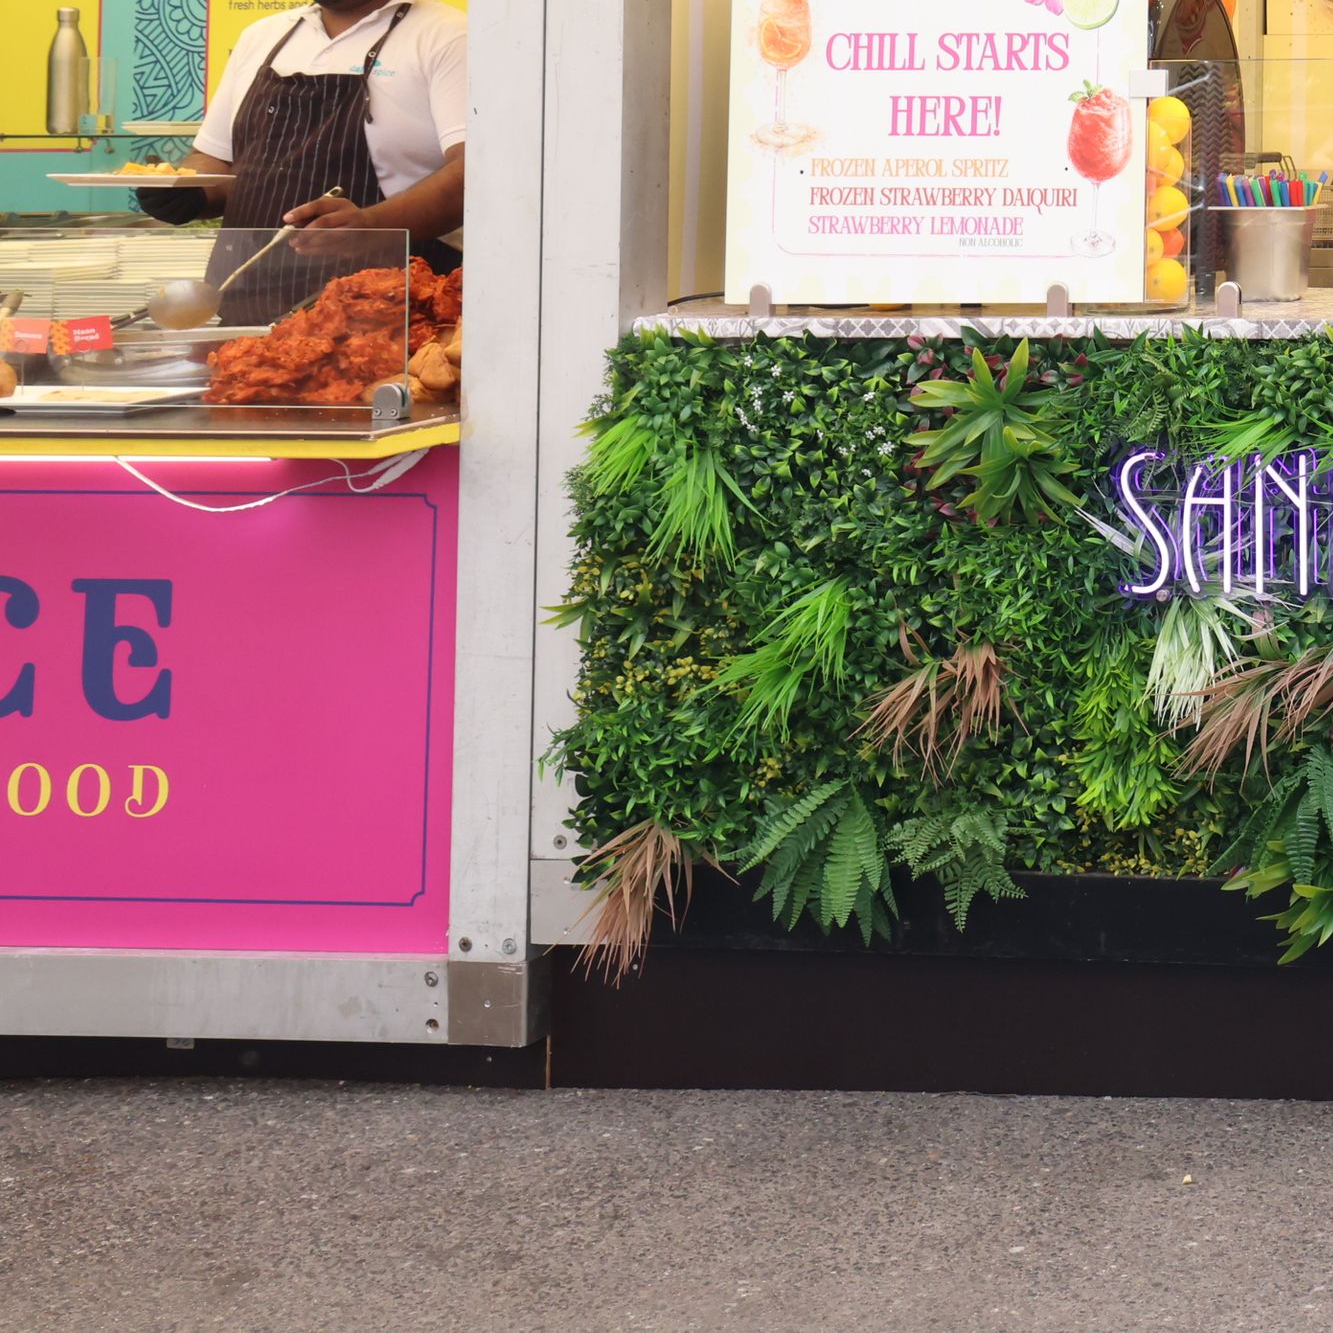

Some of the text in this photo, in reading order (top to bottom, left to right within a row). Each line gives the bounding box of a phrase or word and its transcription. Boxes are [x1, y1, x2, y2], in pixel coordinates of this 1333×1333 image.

[229, 0, 254, 10] fresh
[826, 33, 1070, 71] CHILL STARTS
[888, 96, 1002, 137] HERE!
[811, 158, 1008, 177] FROZEN APEROL SPRITZ
[810, 187, 1078, 215] FROZEN STRAWBERRY DAIQUIRI
[808, 216, 1023, 235] STRAWBERRY LEMONADE
[979, 238, 1023, 248] ALCOHOLIC
